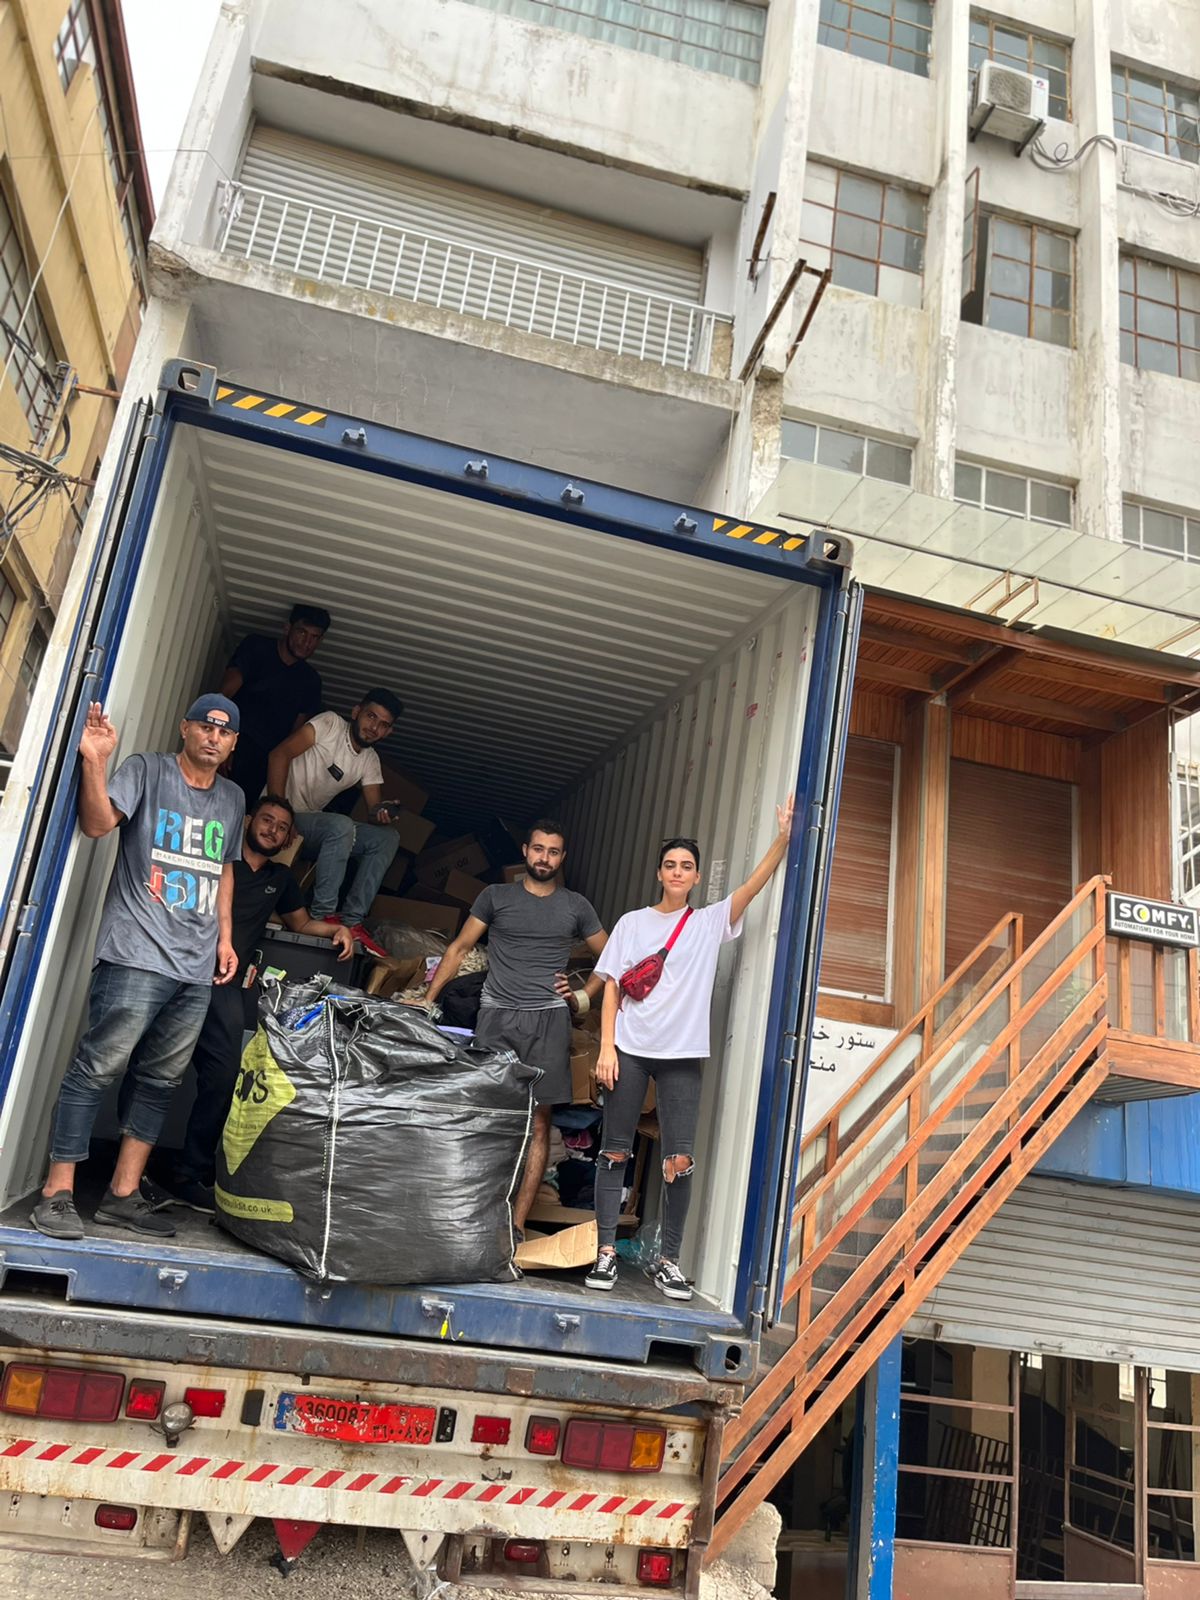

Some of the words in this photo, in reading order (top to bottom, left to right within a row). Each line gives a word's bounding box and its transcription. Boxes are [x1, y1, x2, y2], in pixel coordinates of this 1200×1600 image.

[154, 808, 225, 861] REG
[1114, 921, 1152, 934] AUTOMATISMS
[1165, 930, 1179, 938] YOUR
[835, 1032, 876, 1050] ستور
[305, 1401, 370, 1424] 360087
